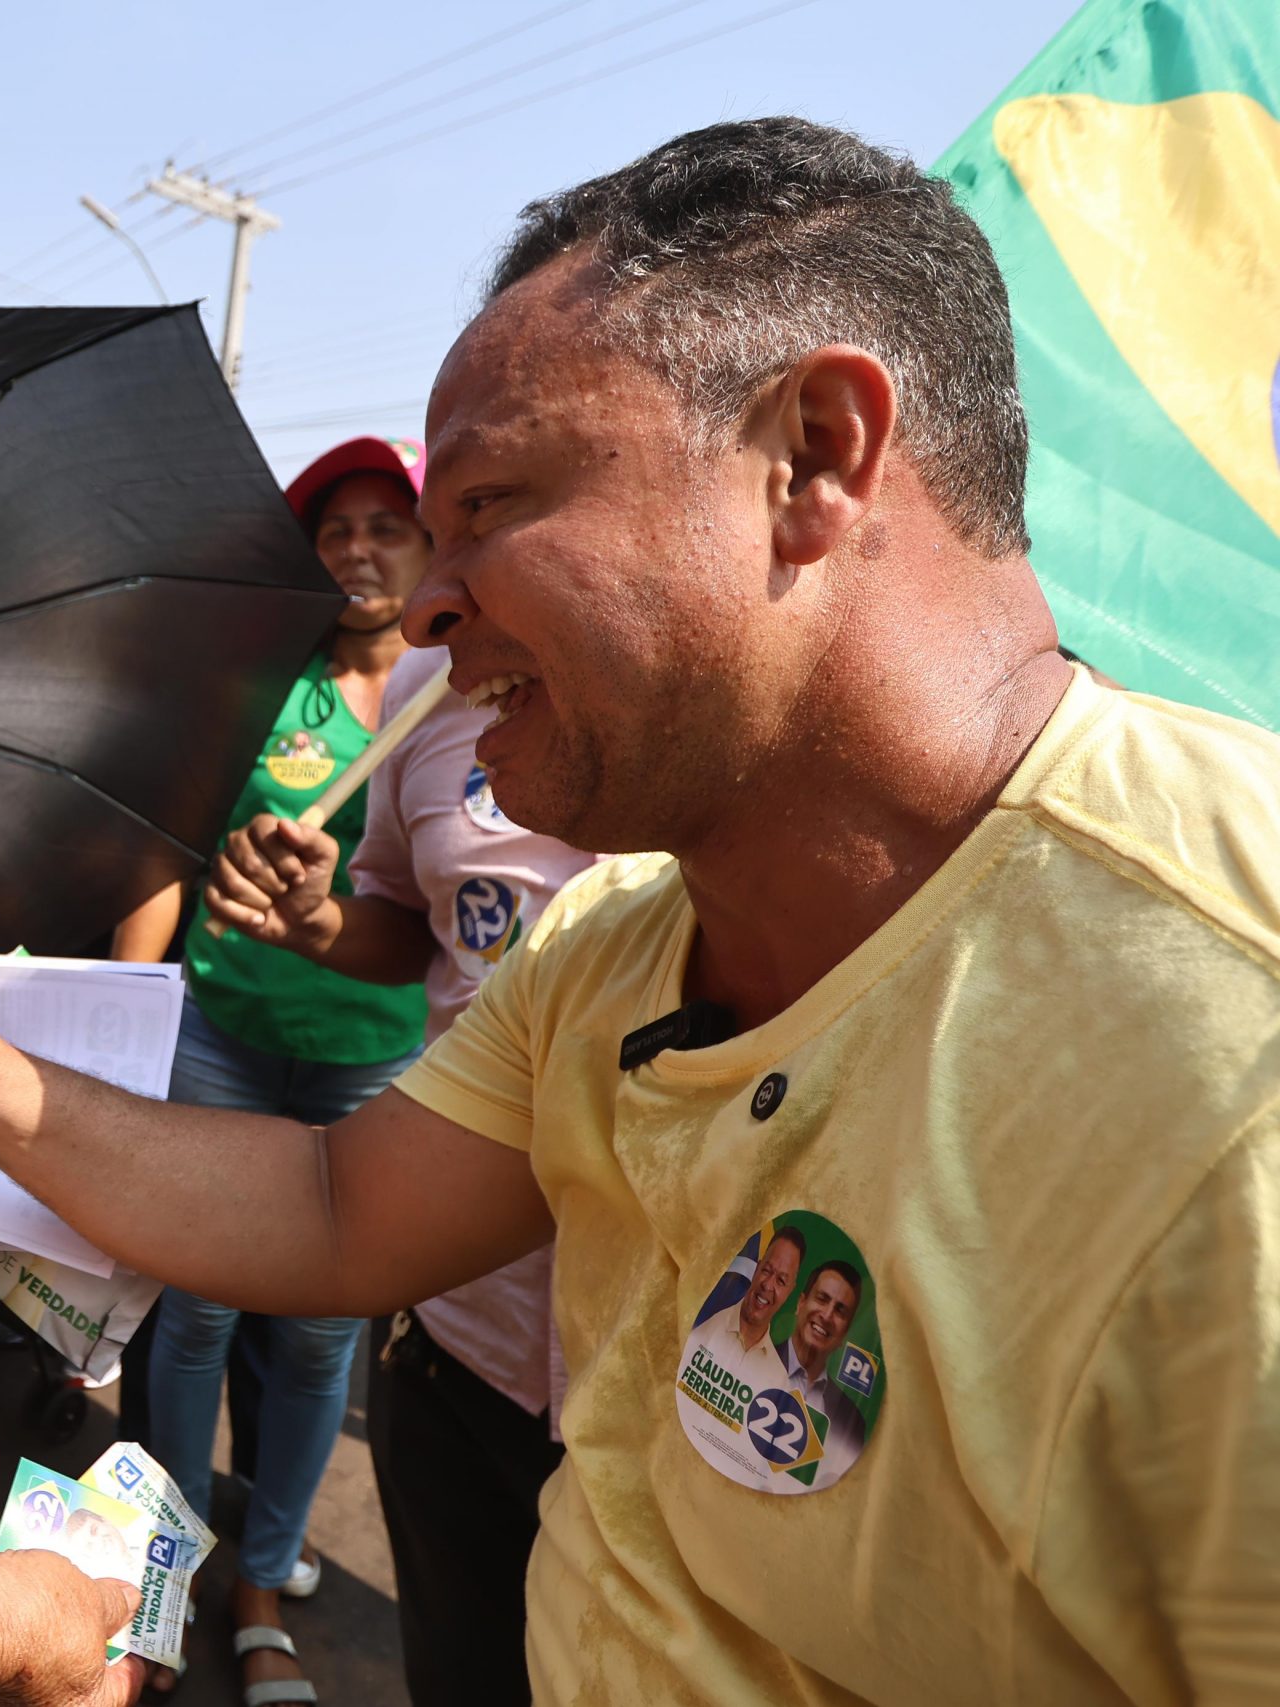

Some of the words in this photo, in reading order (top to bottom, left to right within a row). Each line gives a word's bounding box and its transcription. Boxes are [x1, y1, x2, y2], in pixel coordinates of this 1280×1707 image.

[462, 878, 508, 949] 22
[18, 1266, 102, 1341] VERDADE
[691, 1350, 753, 1403] CLAUDIO
[845, 1355, 870, 1384] PL
[681, 1366, 744, 1425] FERREIRA
[748, 1399, 804, 1459] 22
[117, 1462, 138, 1485] PL
[26, 1493, 60, 1534] 22
[151, 1538, 170, 1563] PL
[146, 1569, 168, 1634] VERDADE
[129, 1640, 141, 1649] A
[143, 1637, 156, 1654] DE
